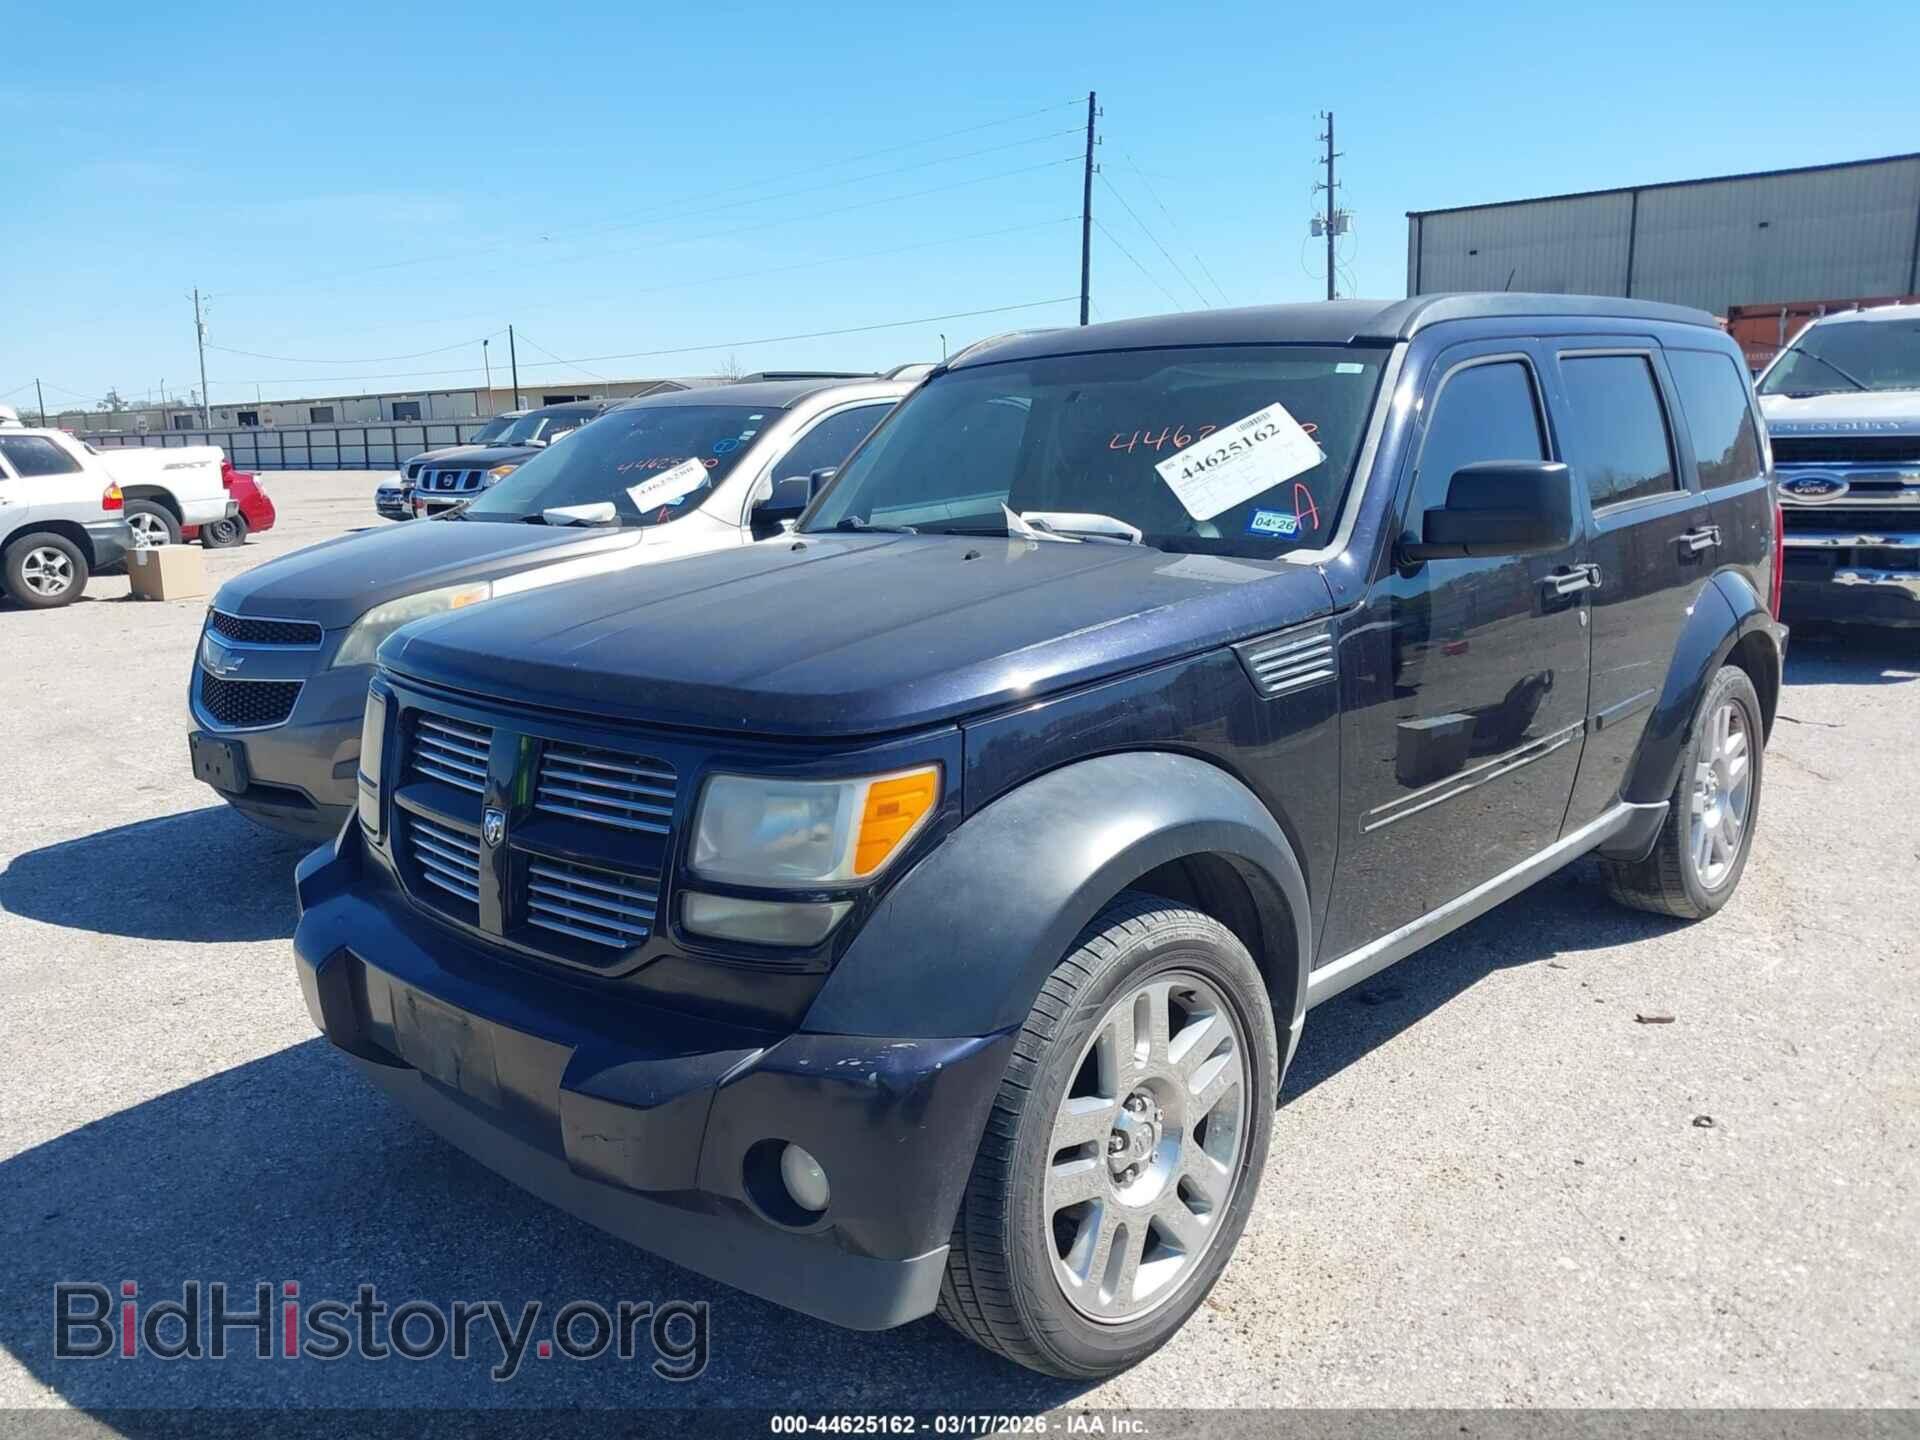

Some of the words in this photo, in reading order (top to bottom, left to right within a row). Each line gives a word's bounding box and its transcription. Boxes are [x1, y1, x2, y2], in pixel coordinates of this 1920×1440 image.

[1180, 422, 1281, 481] 44625162
[1794, 479, 1829, 493] Ford
[1293, 483, 1319, 530] A
[1255, 517, 1272, 527] 04
[1278, 520, 1294, 530] 26
